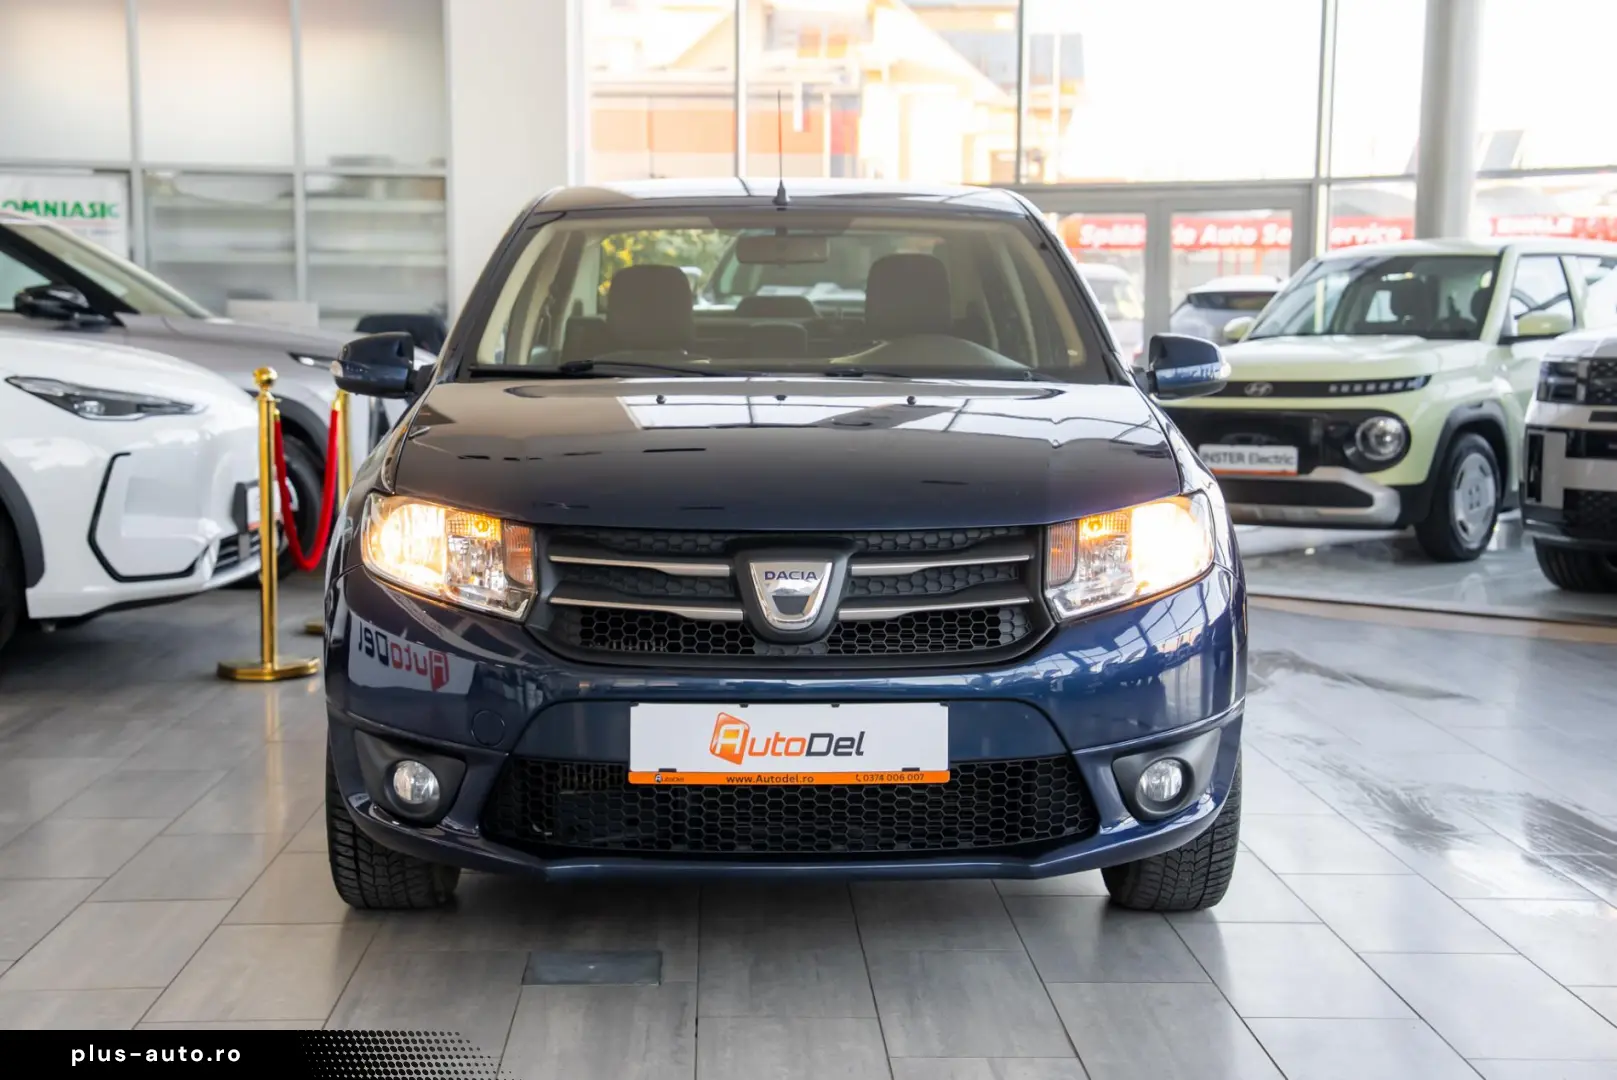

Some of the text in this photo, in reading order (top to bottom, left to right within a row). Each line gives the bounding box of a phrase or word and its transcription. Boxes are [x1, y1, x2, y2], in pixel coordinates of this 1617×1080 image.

[1200, 223, 1257, 245] Auto
[1331, 222, 1402, 244] ervice
[1248, 453, 1295, 466] Electric
[764, 571, 818, 580] DACIA
[710, 713, 865, 765] AutoDel
[726, 774, 814, 784] www.Autodel.ro
[863, 774, 884, 782] 0374
[907, 773, 924, 782] 007
